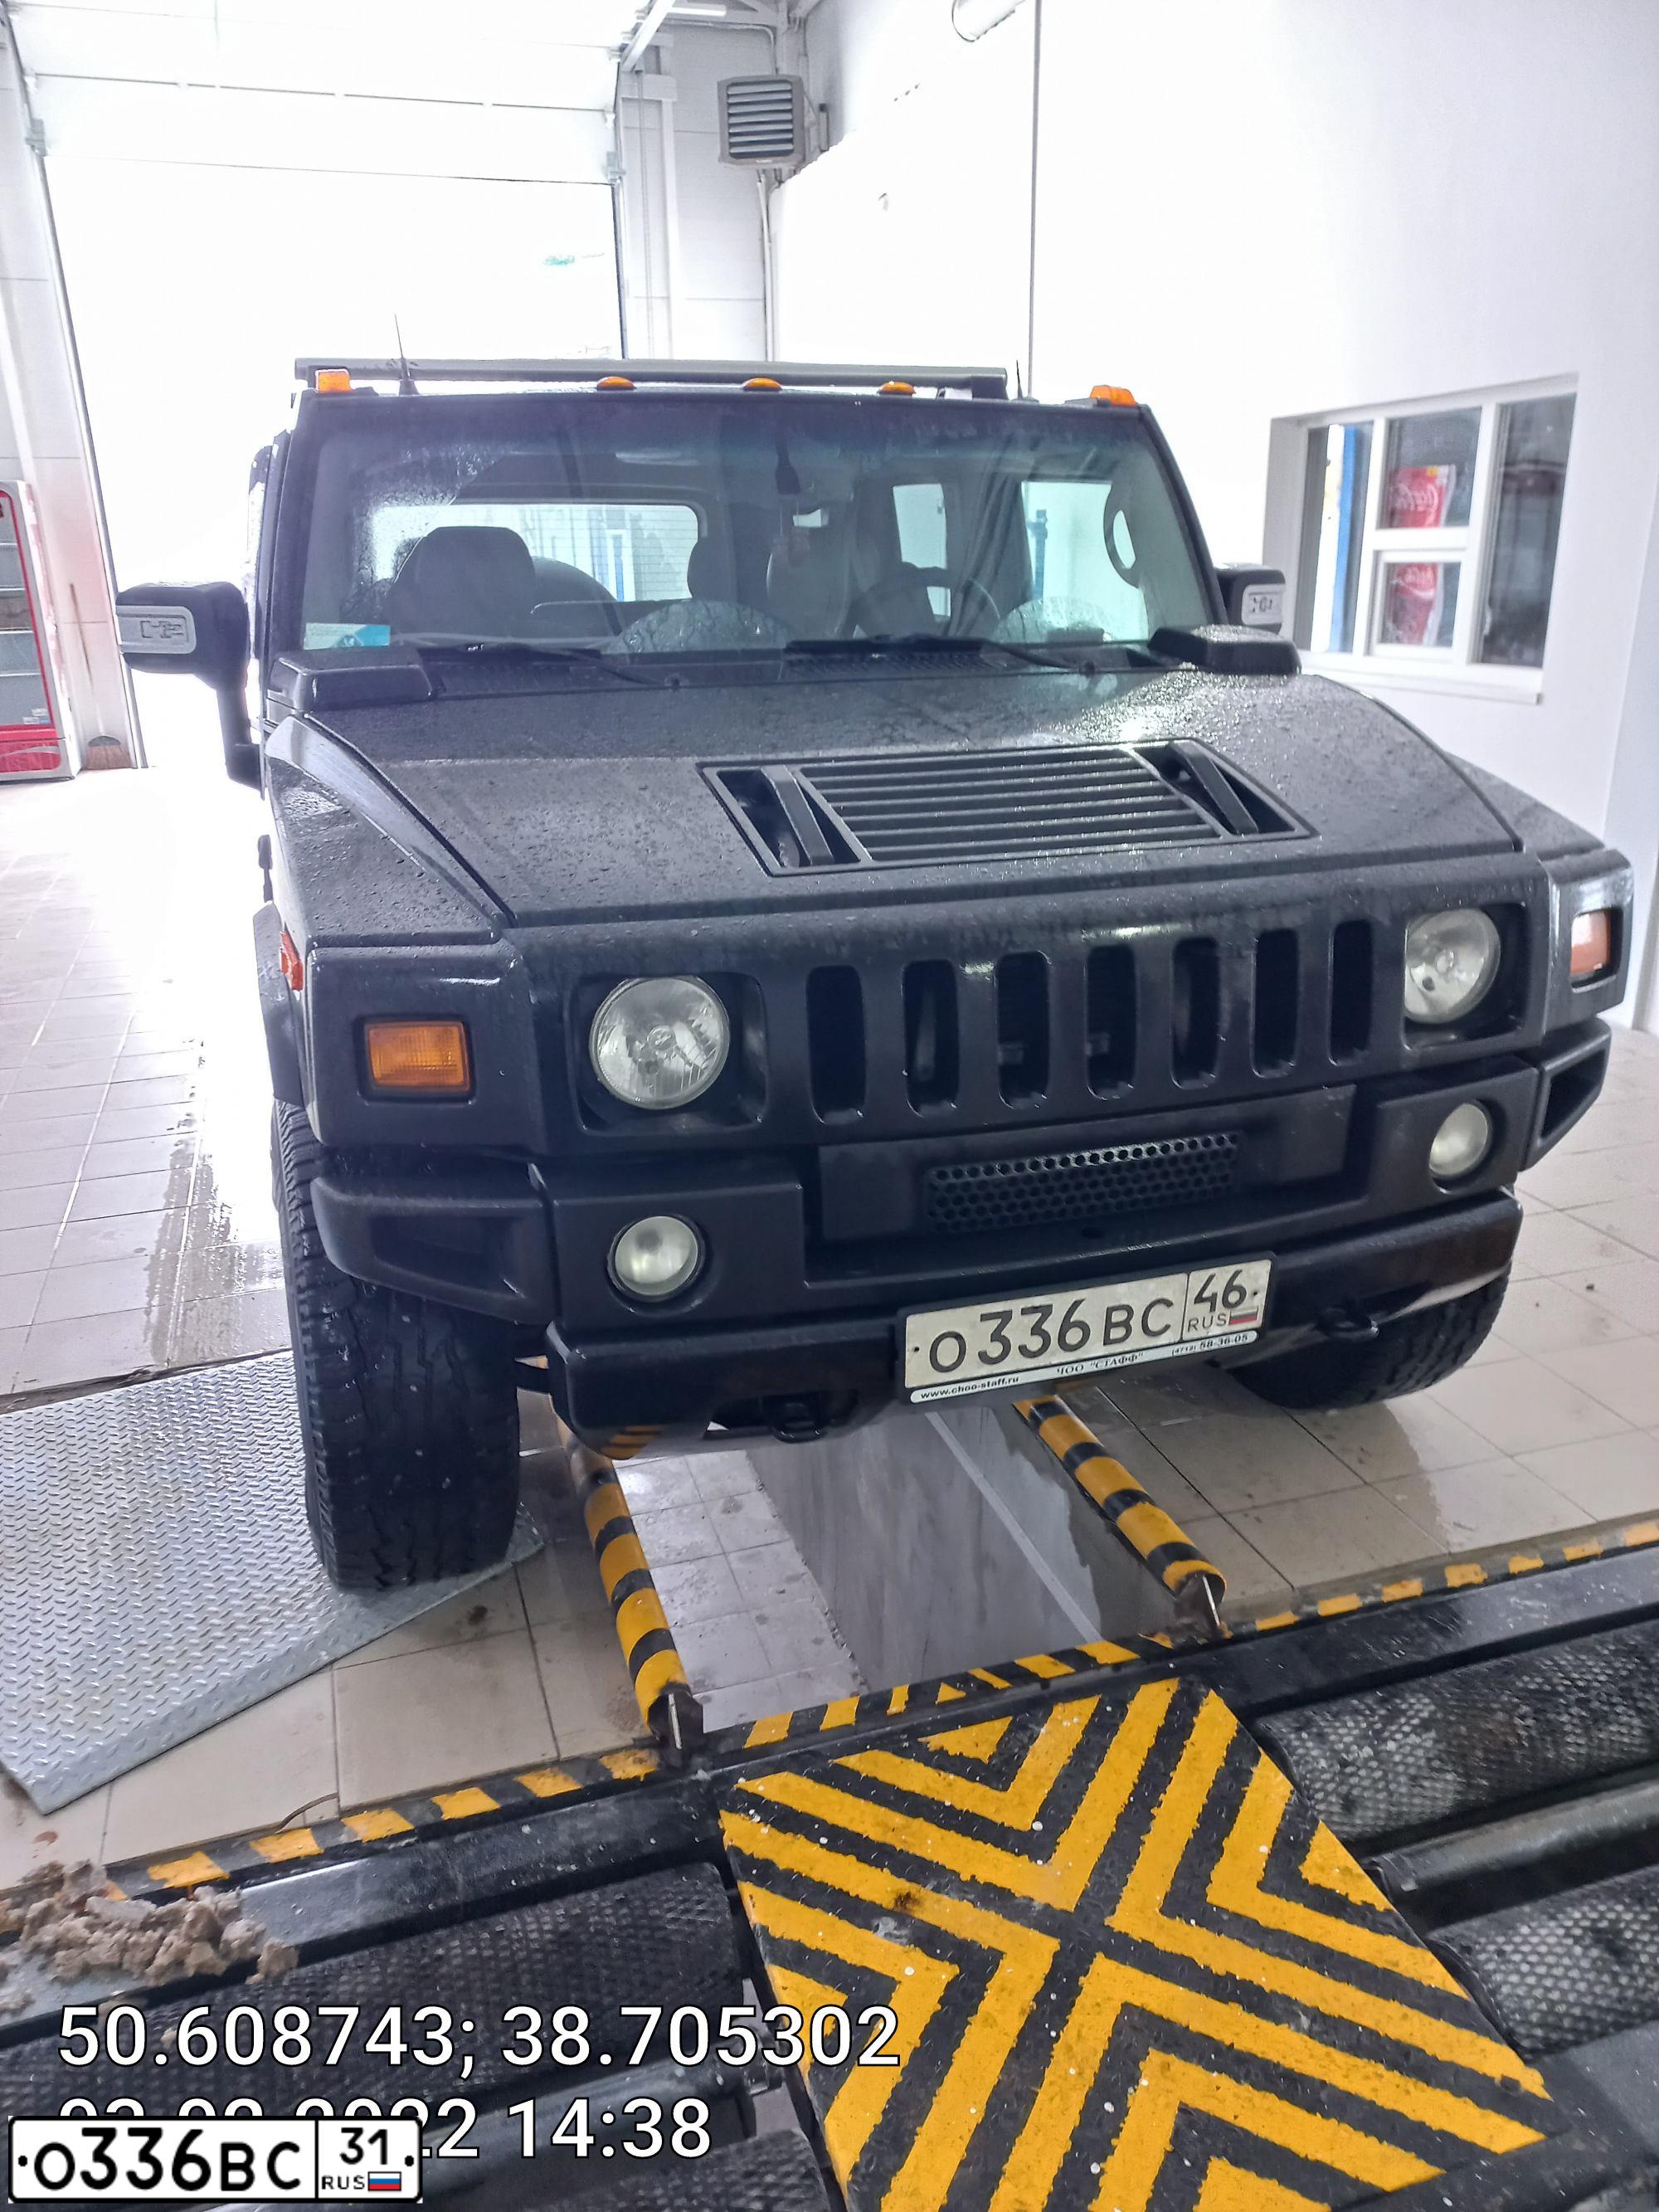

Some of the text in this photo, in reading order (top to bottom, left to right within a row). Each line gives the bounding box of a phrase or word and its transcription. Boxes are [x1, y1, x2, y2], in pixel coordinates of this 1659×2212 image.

[1193, 1269, 1248, 1313] 46
[1187, 1313, 1227, 1333] RUS
[921, 1376, 1019, 1400] www.choo-staff.ru
